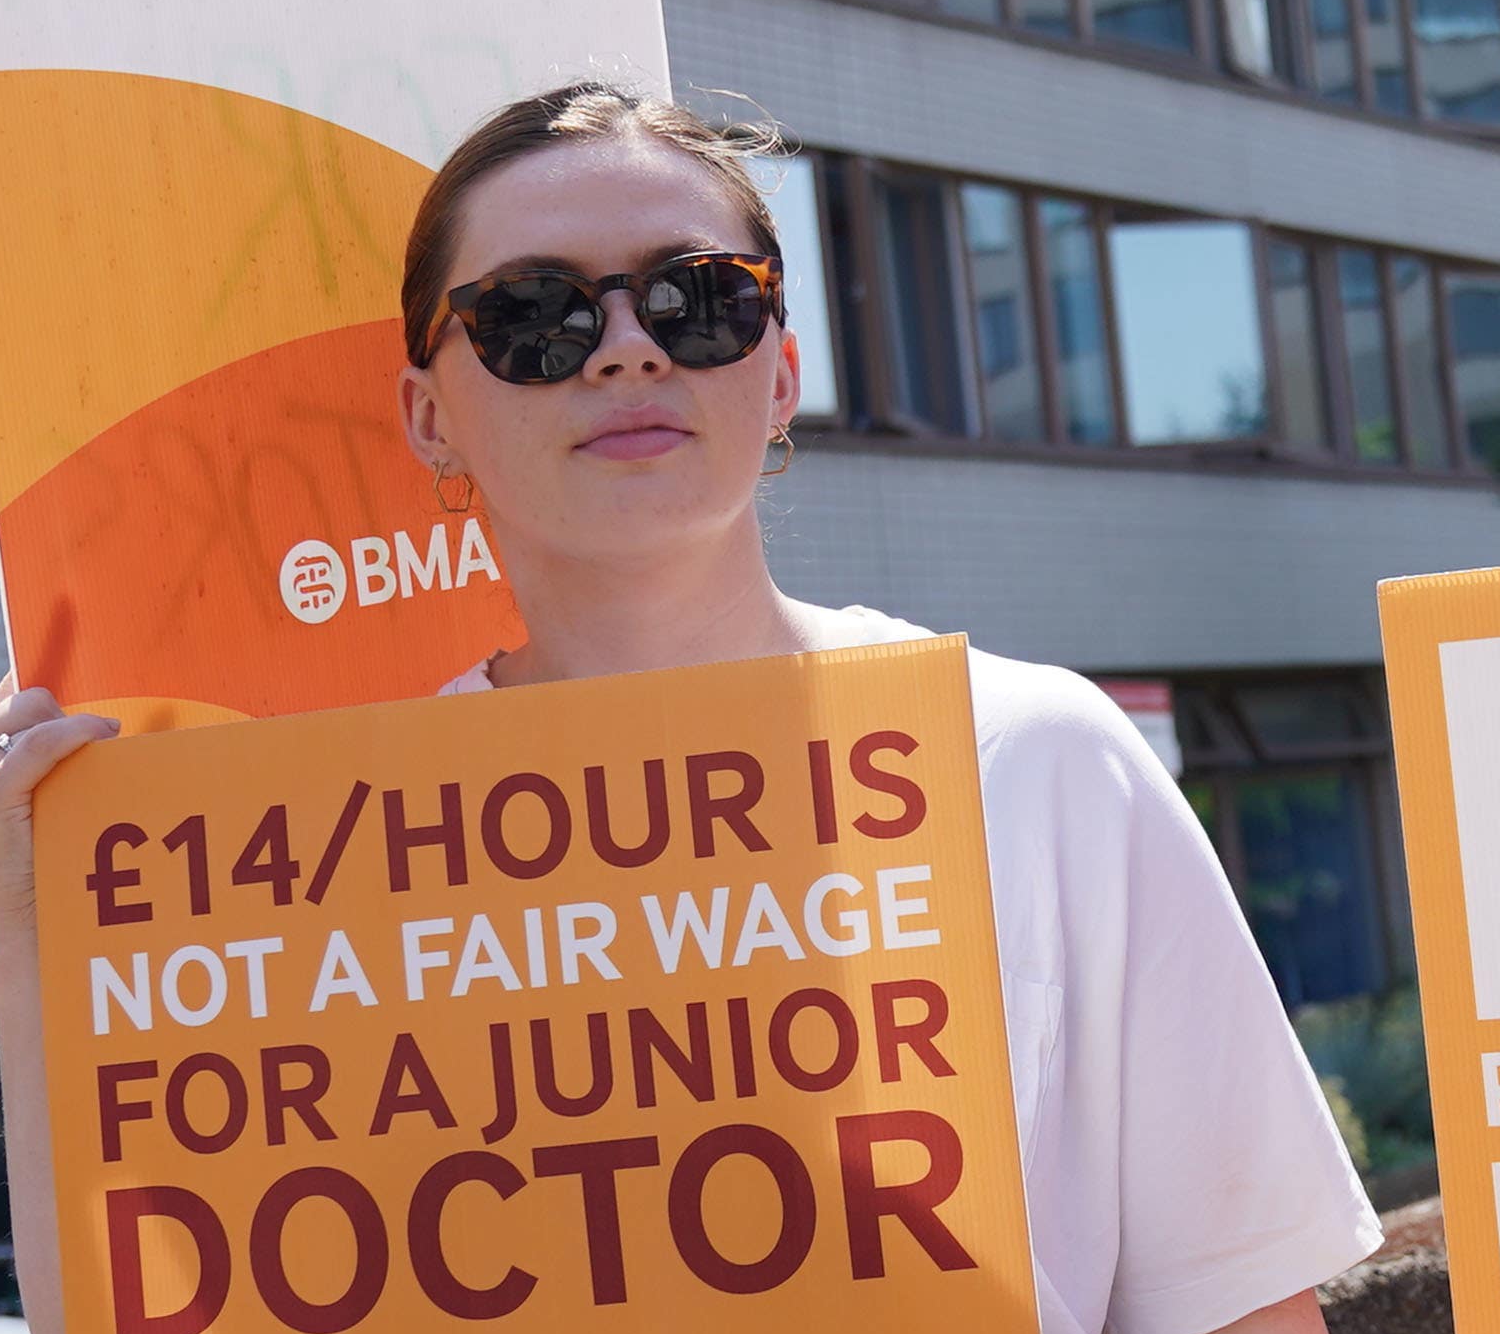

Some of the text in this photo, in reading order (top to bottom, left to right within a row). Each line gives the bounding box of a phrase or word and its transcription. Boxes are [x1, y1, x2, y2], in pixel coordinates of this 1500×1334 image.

[351, 518, 501, 607] BMA
[86, 731, 928, 927] £14/HOUR IS
[90, 865, 940, 1035] NOT A FAIR WAGE
[97, 980, 961, 1162] FOR A JUNIOR
